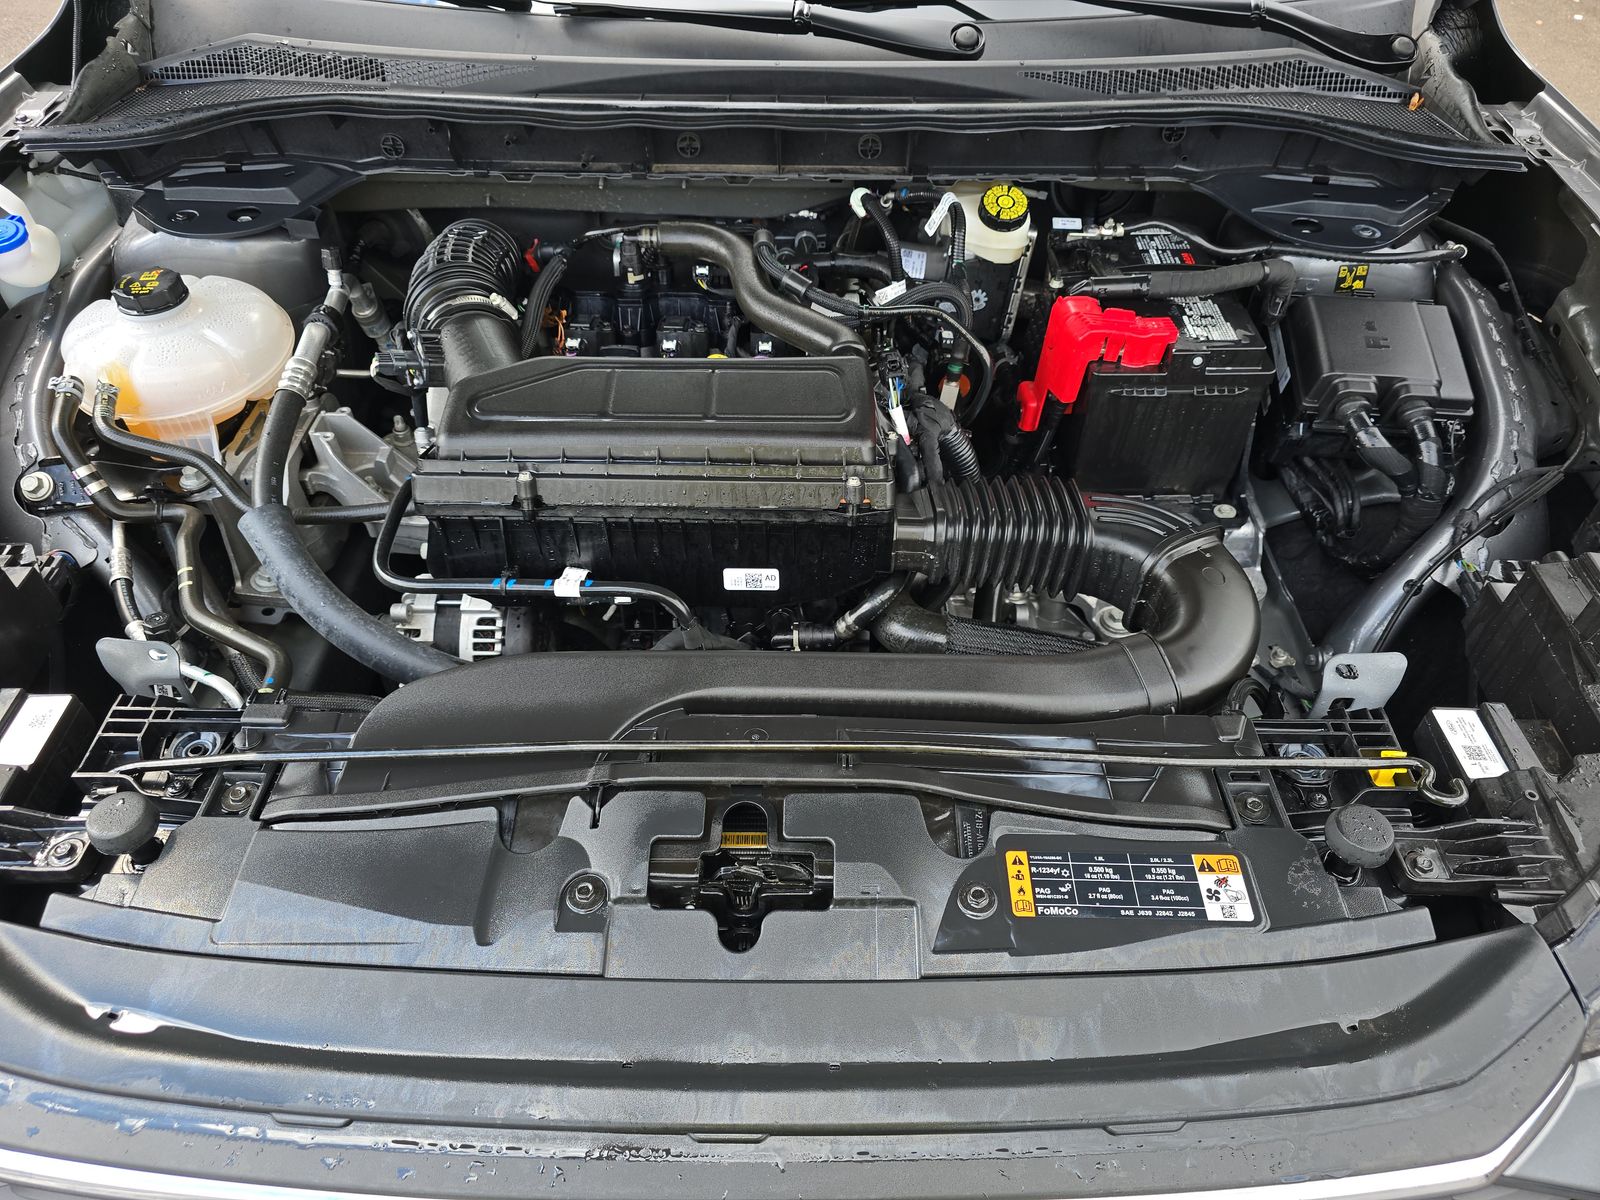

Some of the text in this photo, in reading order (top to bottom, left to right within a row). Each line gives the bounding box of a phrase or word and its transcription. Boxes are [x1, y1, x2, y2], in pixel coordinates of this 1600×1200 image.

[1031, 866, 1060, 875] R-1234yf
[1104, 867, 1114, 875] kg
[1037, 906, 1079, 916] FoMoCo
